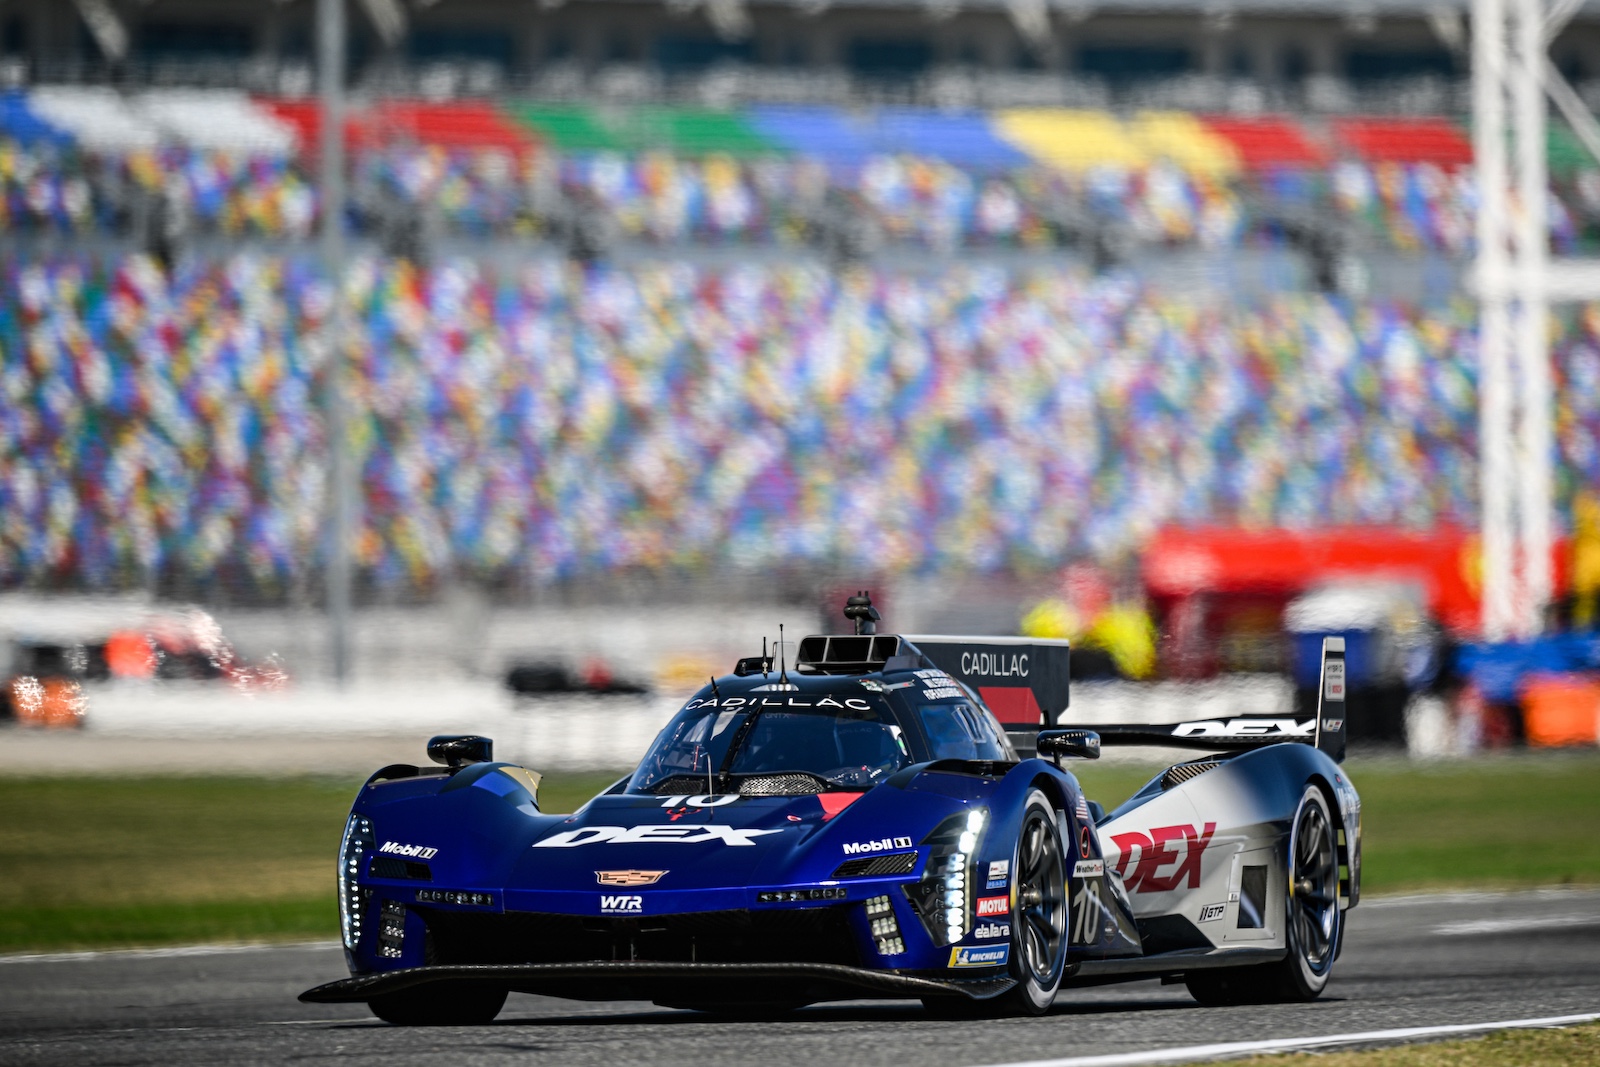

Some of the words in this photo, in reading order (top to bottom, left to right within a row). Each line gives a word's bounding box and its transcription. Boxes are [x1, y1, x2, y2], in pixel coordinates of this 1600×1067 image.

[961, 651, 1029, 677] CADILLAC
[685, 697, 871, 711] CADILLAC
[1171, 718, 1317, 737] DEX
[532, 825, 785, 848] DEX
[379, 841, 424, 857] Mobil
[420, 847, 437, 859] 1
[843, 838, 894, 855] Mobil
[895, 837, 911, 848] 1
[1109, 822, 1217, 894] DEX
[1075, 863, 1103, 874] WeatherTech
[601, 895, 643, 909] WTR
[979, 898, 1008, 914] MOTUL
[1073, 880, 1100, 945] 10
[974, 923, 1010, 939] dallara
[970, 951, 1005, 961] MICHELIN
